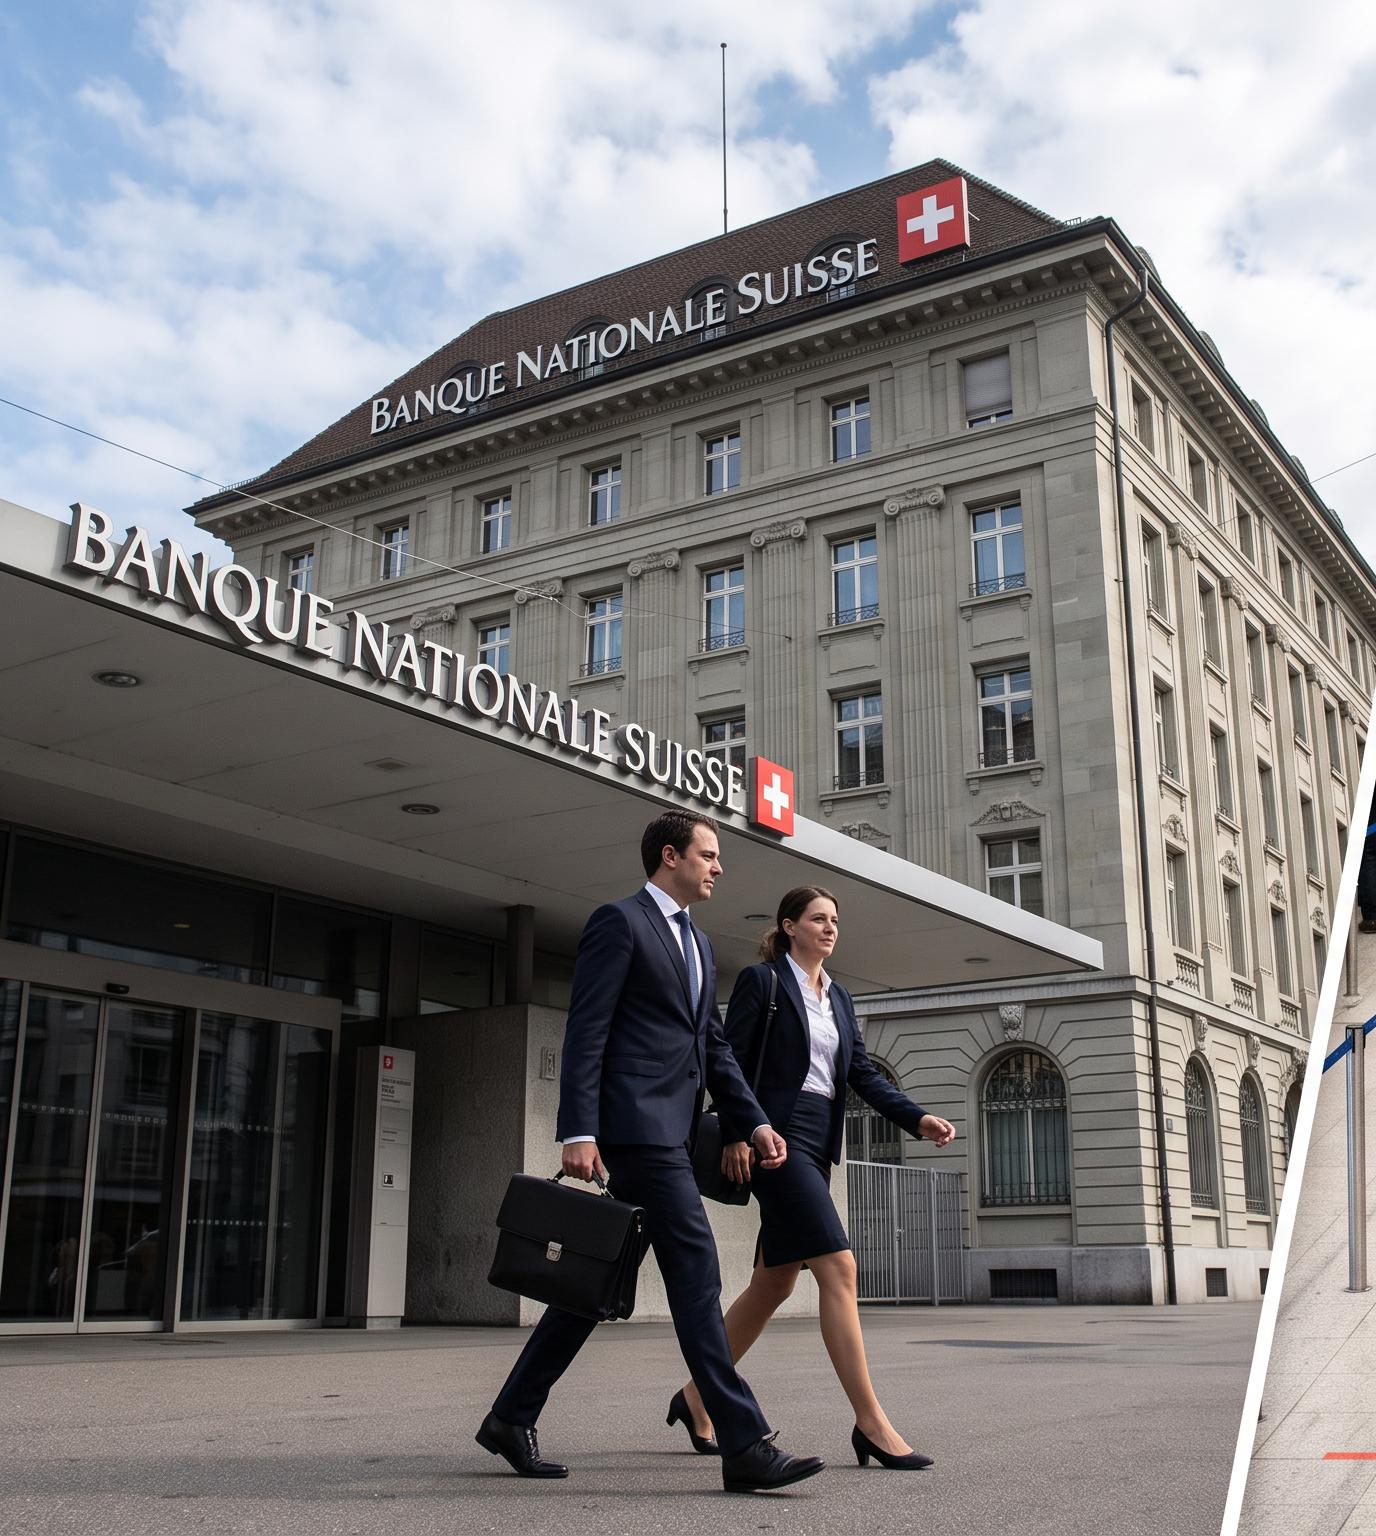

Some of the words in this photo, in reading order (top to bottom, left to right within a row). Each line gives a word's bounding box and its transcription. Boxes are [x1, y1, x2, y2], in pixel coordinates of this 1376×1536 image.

[370, 361, 505, 435] BANQUE
[516, 288, 726, 388] NATIONALE
[738, 239, 879, 315] SUISSE
[64, 502, 335, 658] BANQUE
[346, 610, 613, 762] NATIONALE
[618, 723, 745, 813] SUISSE
